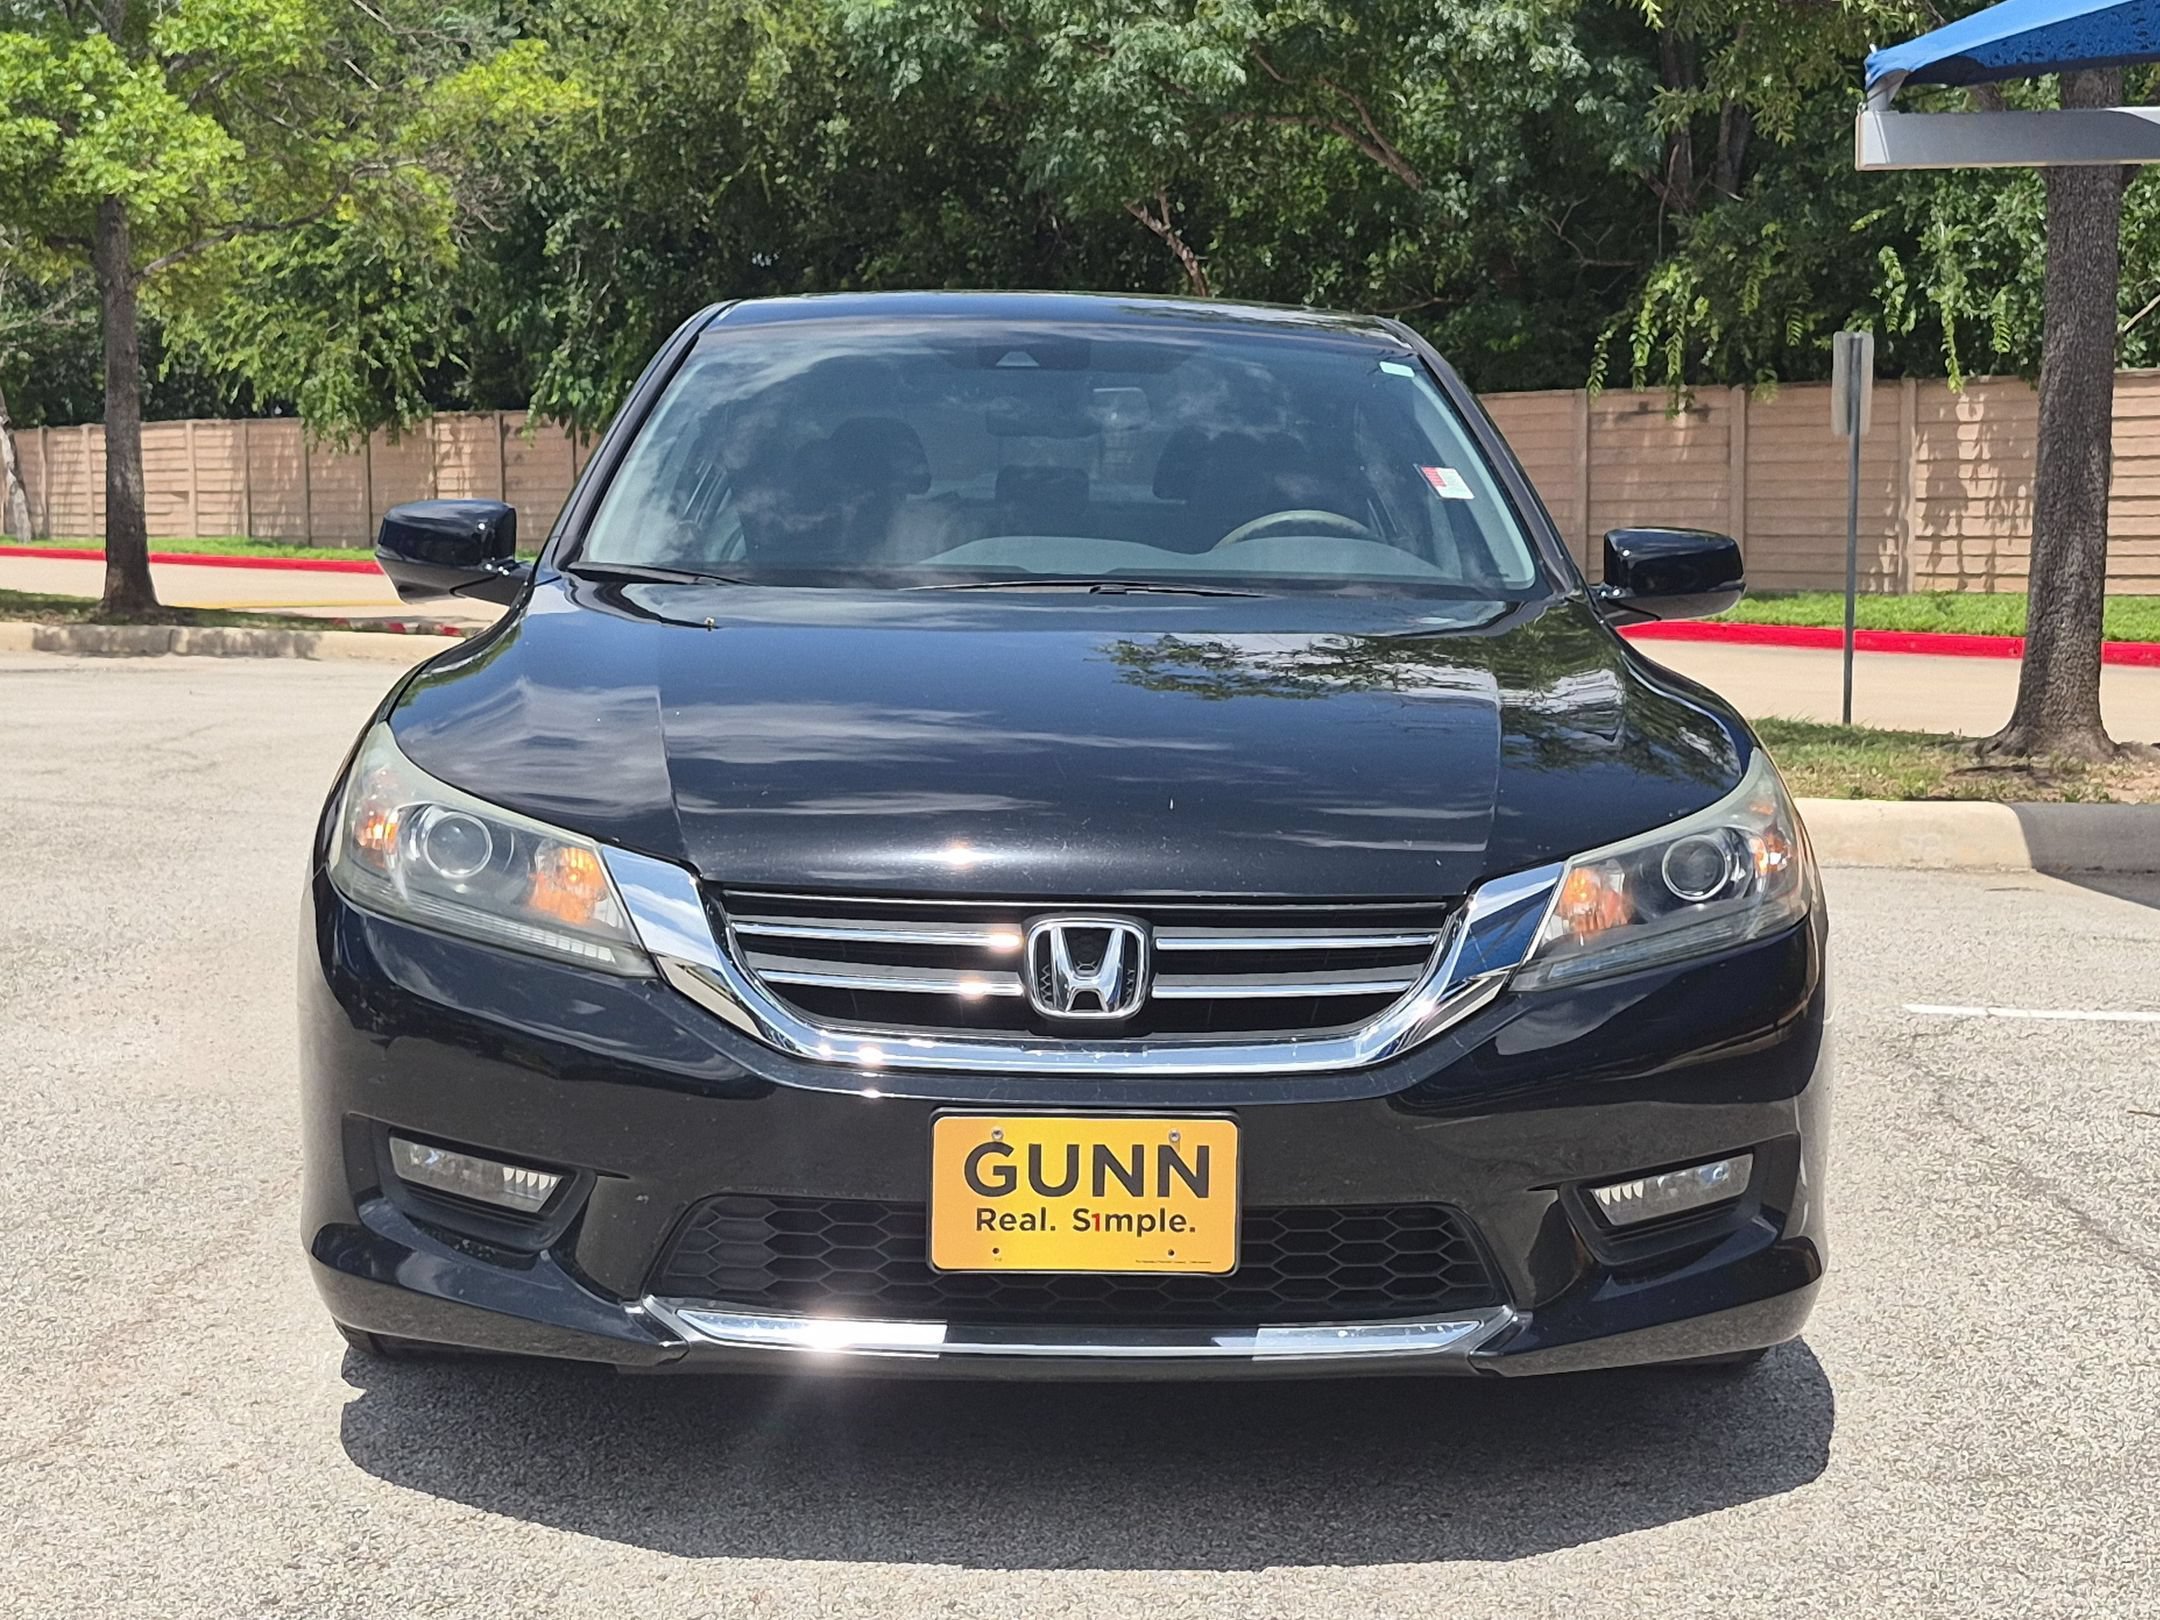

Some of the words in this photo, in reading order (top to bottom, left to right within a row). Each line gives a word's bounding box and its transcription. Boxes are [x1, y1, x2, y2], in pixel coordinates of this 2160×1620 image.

[964, 1140, 1210, 1198] GUNN
[976, 1207, 1056, 1232] Real.
[1073, 1208, 1196, 1237] S1mple.
